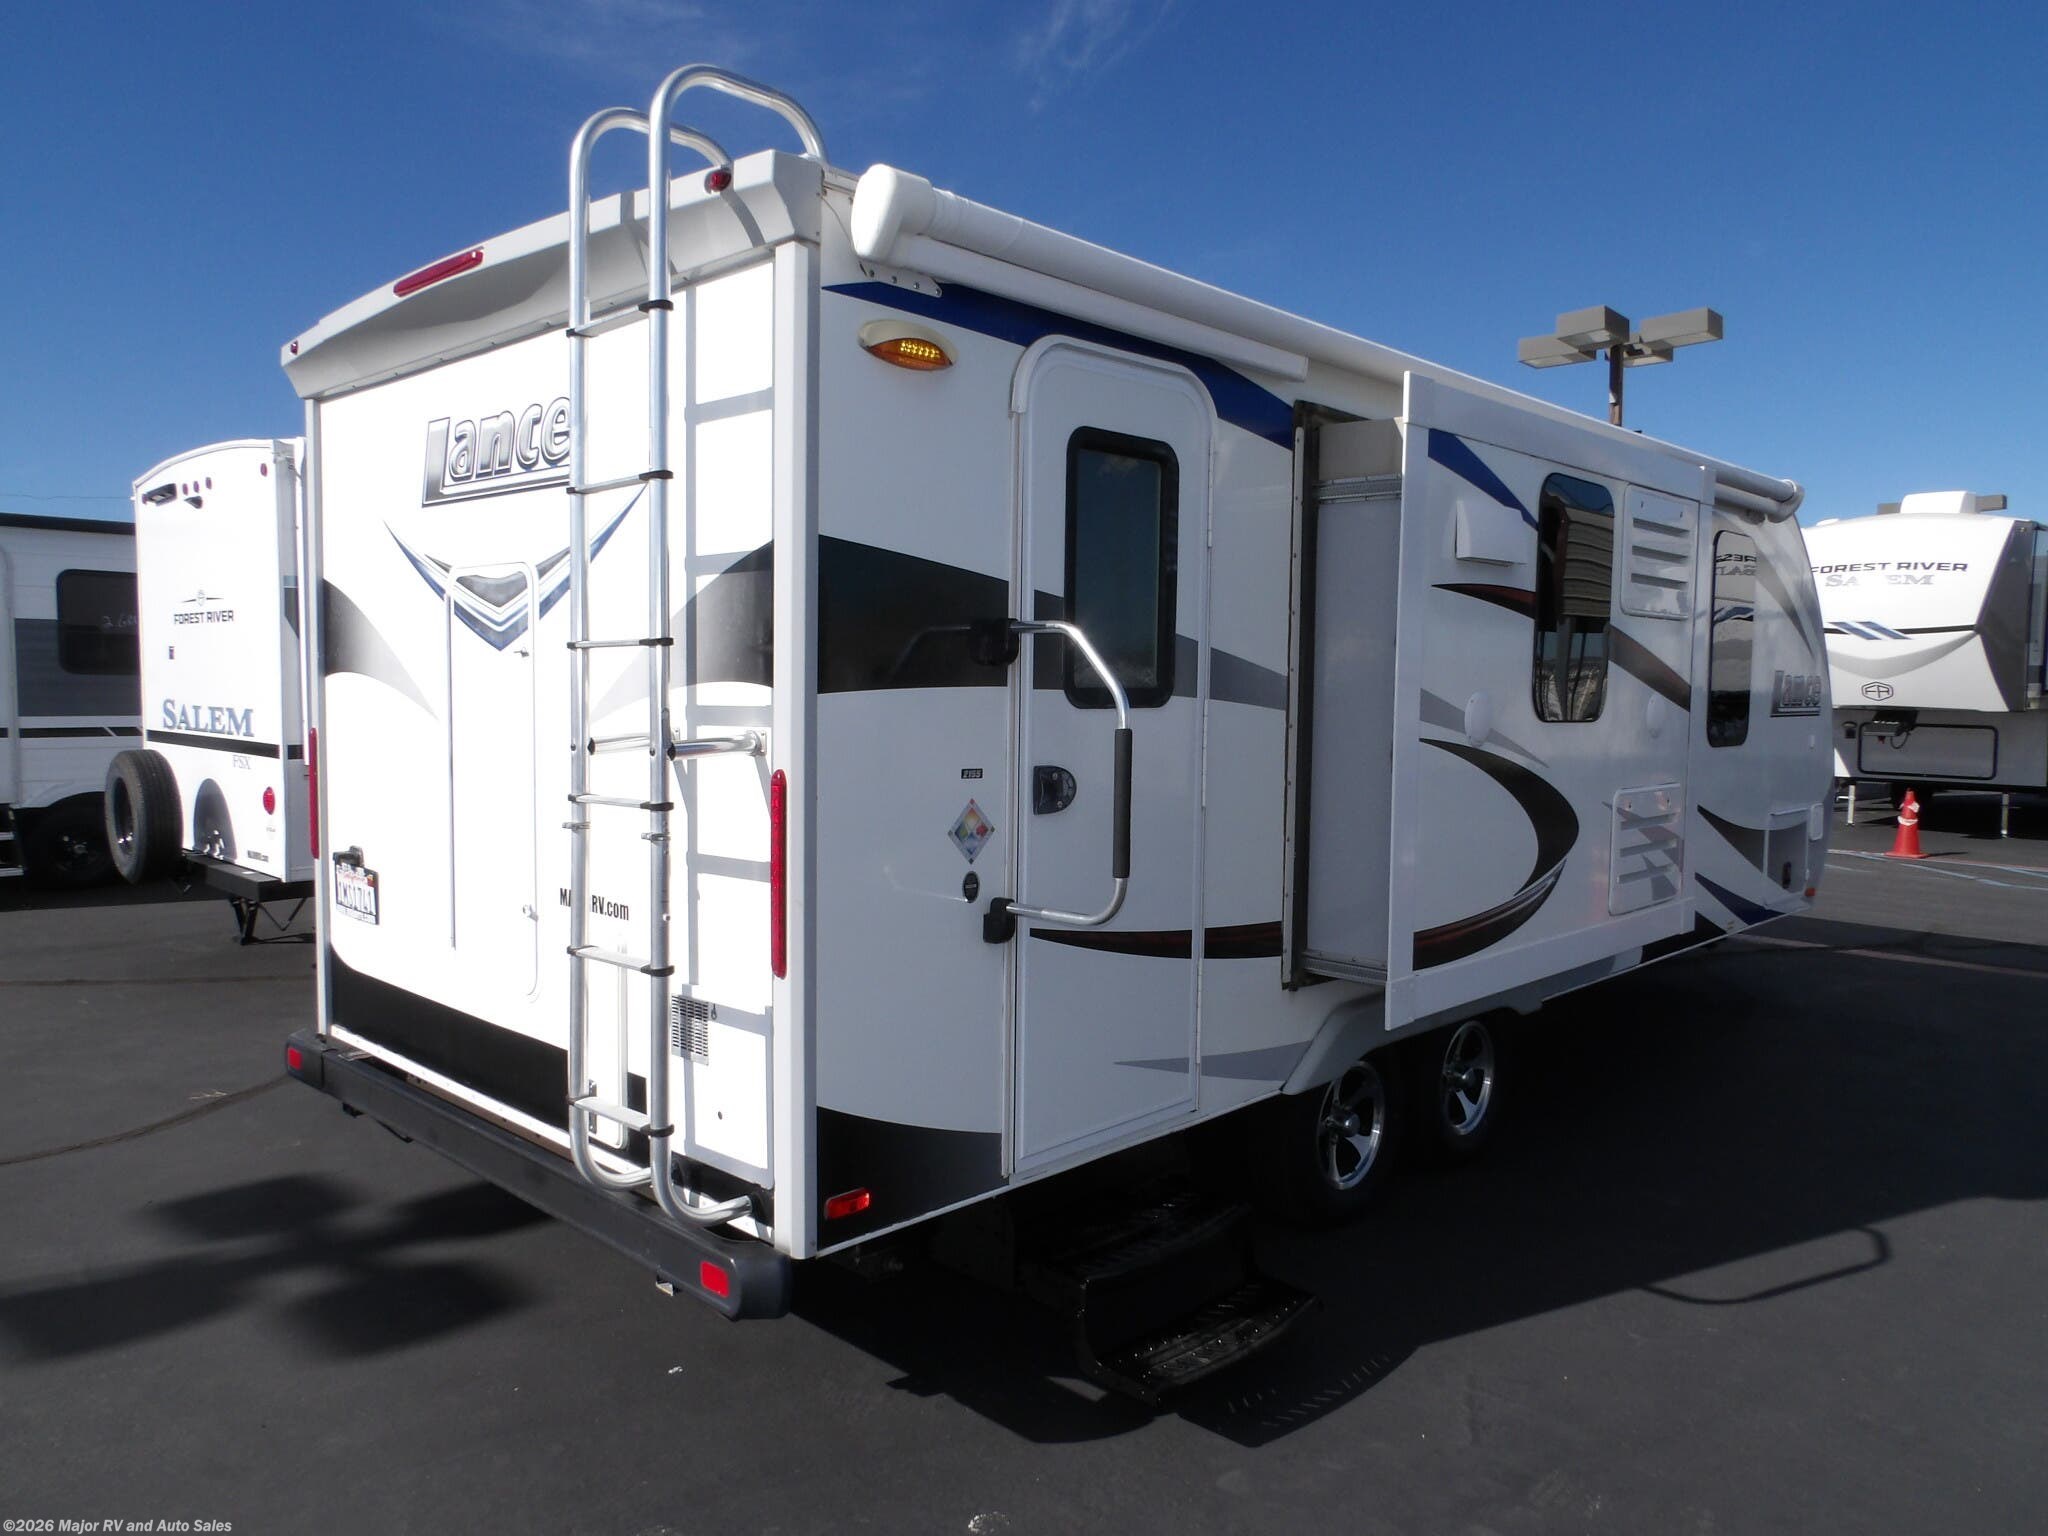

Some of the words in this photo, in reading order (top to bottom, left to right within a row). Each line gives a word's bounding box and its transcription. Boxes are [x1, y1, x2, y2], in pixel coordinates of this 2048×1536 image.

[421, 396, 571, 508] Lance
[1896, 561, 1969, 573] RIVER
[1825, 574, 1935, 588] SAEM
[174, 611, 205, 625] FOREST
[206, 609, 235, 623] RIVER
[162, 698, 255, 738] SALEM
